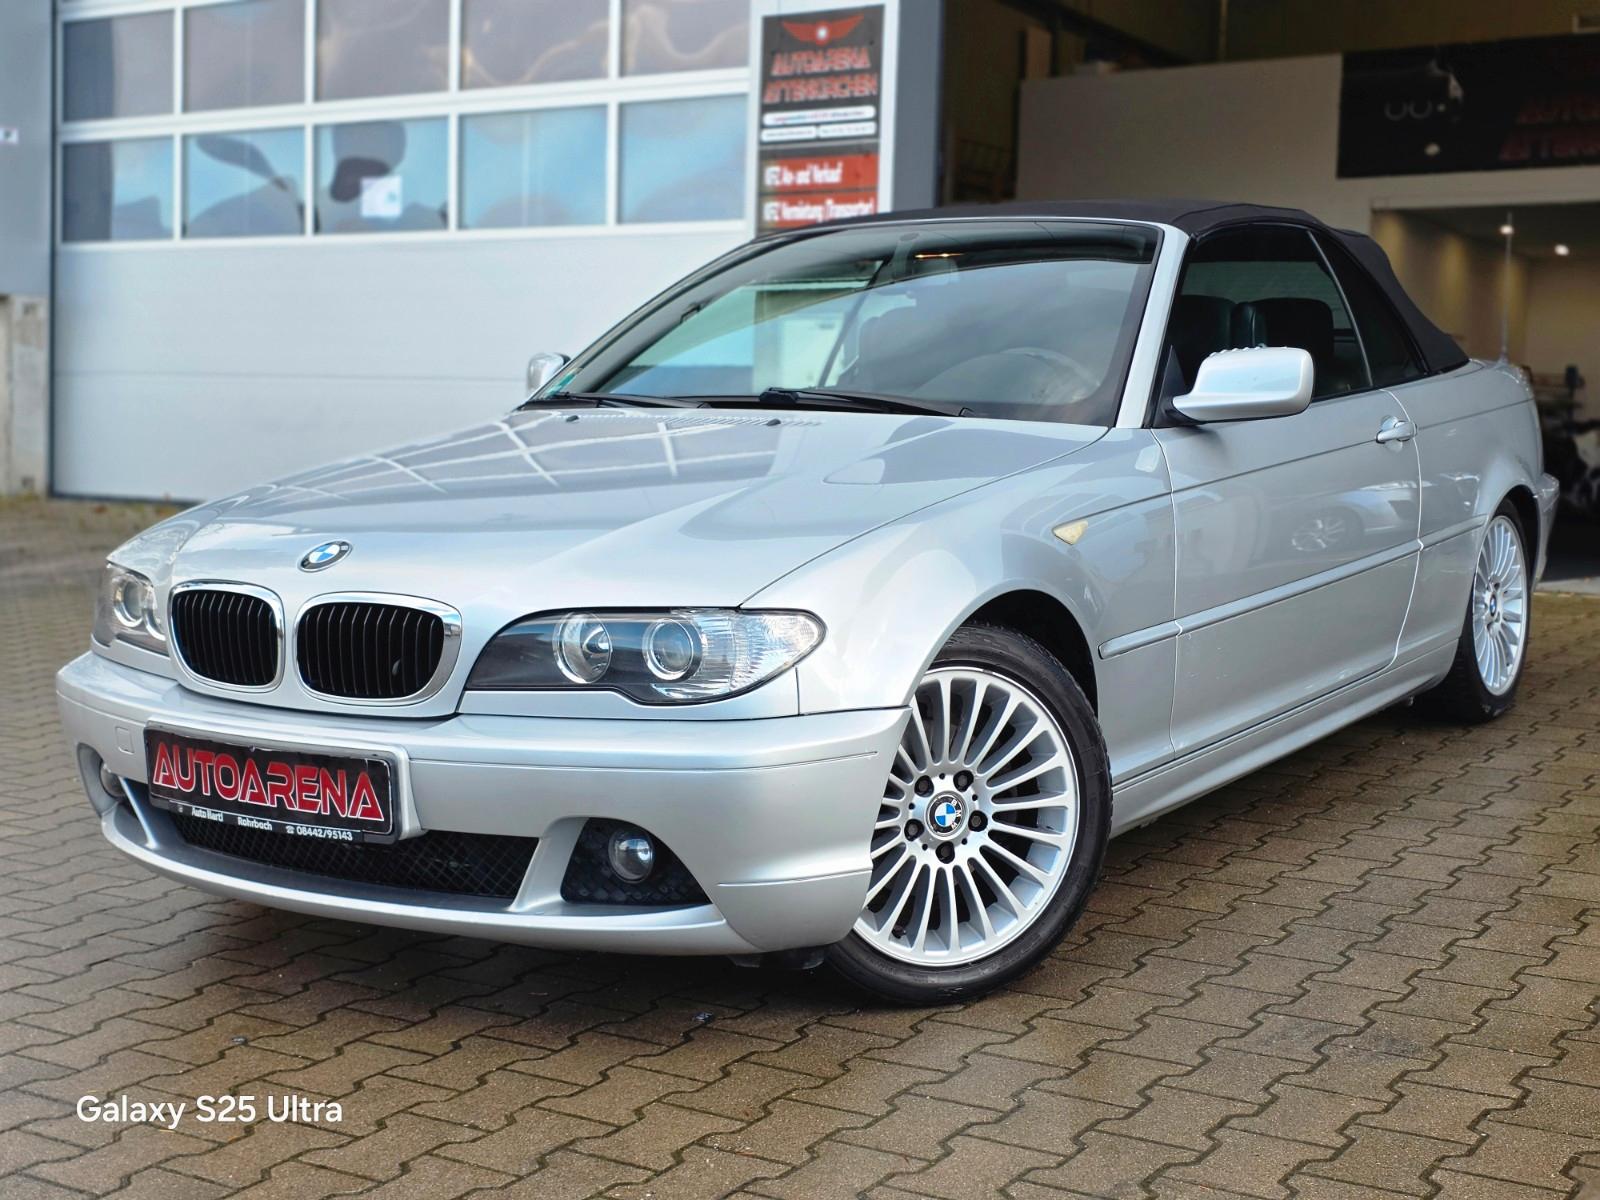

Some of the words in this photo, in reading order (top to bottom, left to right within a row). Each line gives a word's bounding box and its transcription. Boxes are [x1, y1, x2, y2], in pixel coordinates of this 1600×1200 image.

[153, 741, 384, 821] AUTOARENA
[238, 816, 273, 830] Rohrbach
[296, 826, 353, 842] 08442/95143
